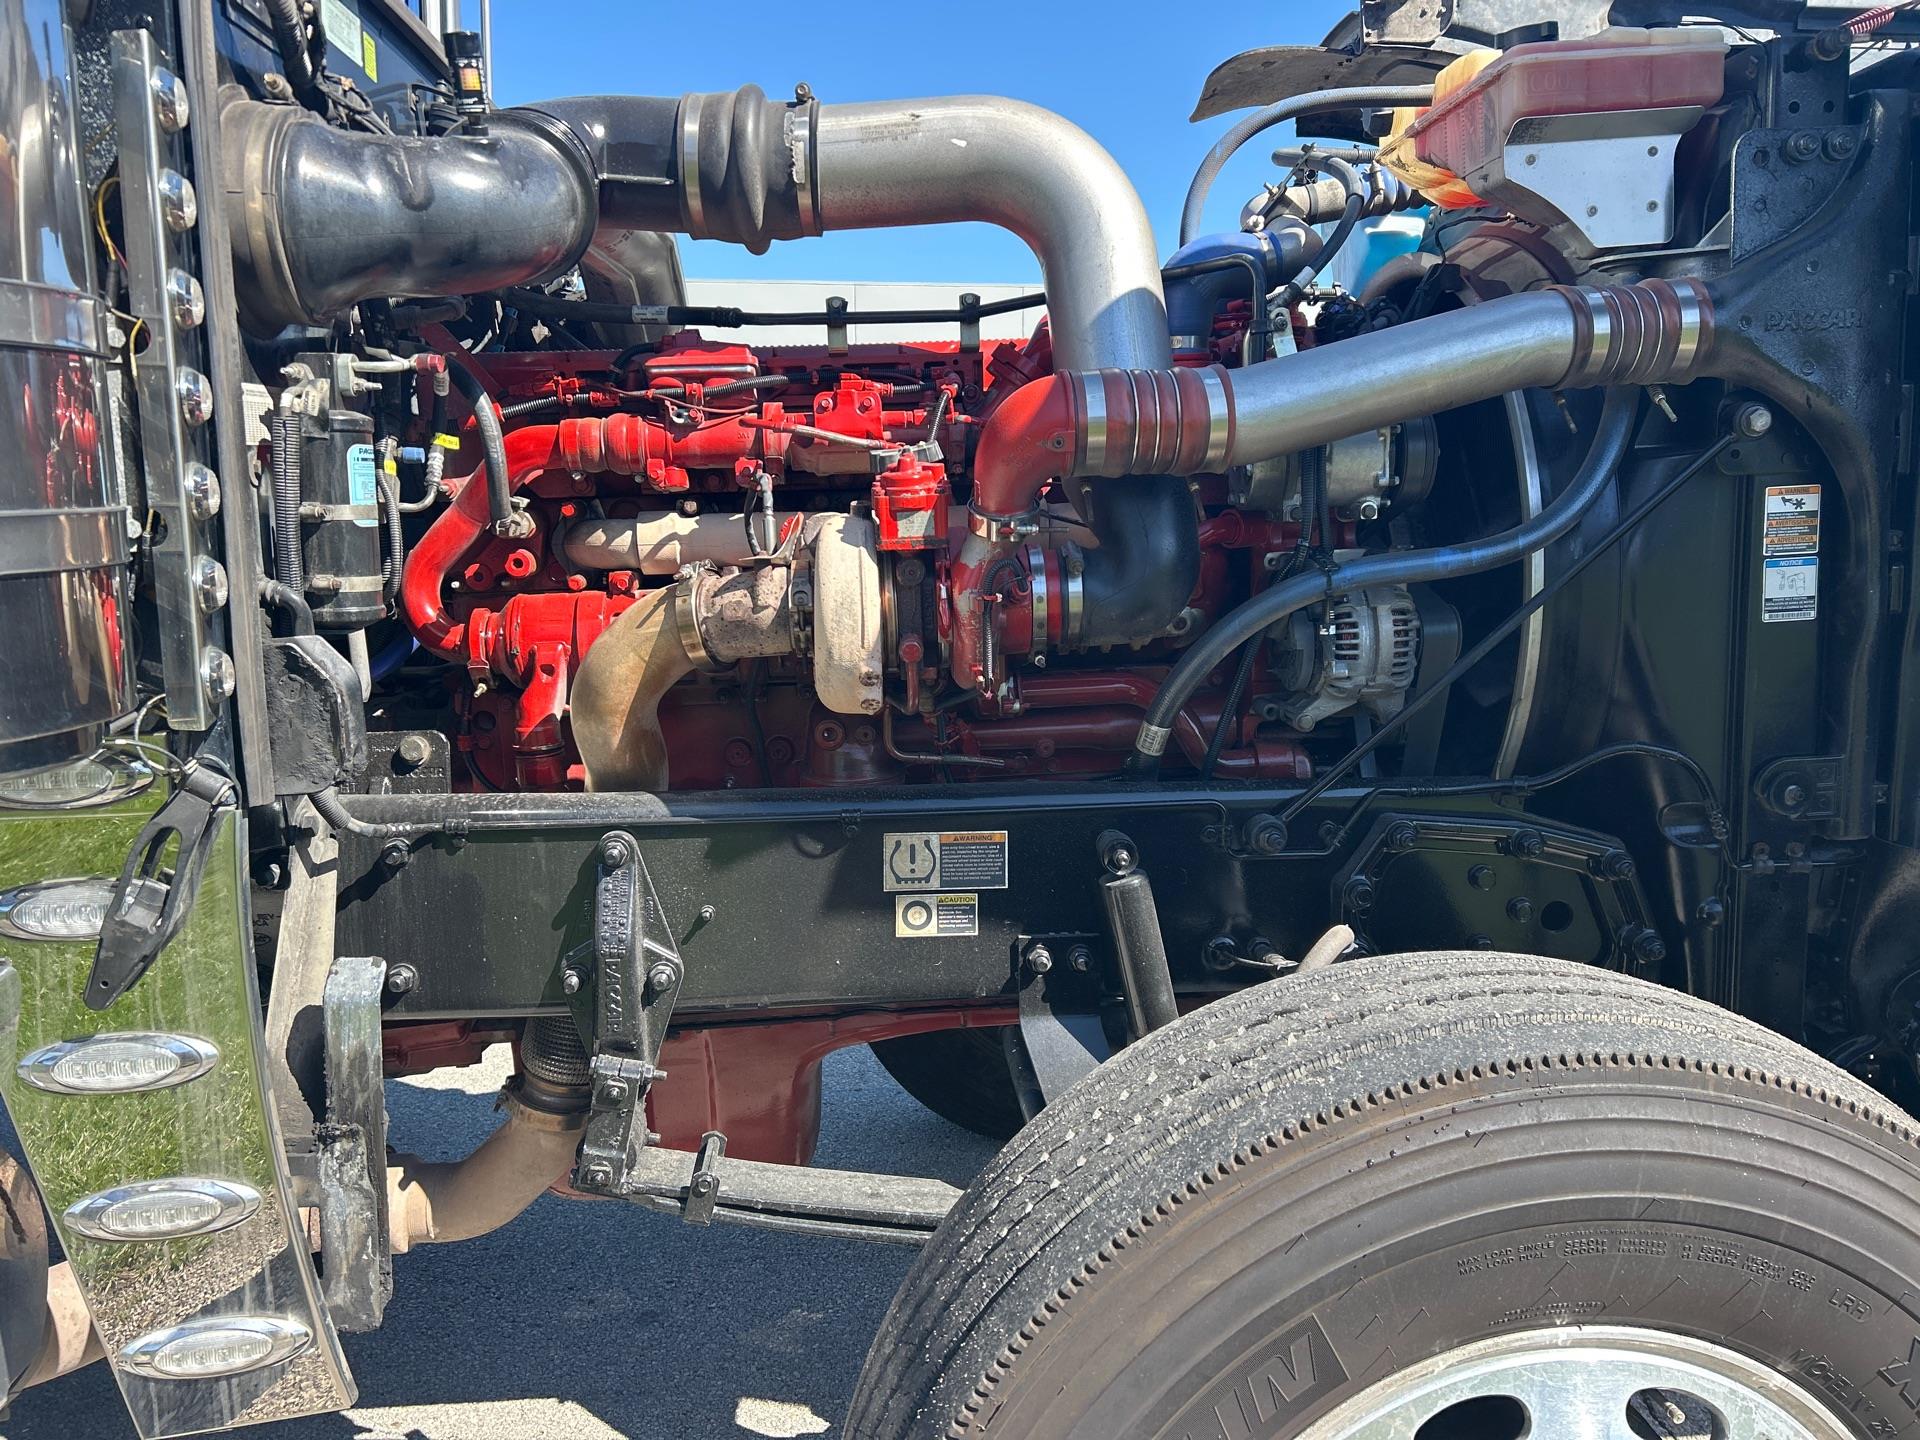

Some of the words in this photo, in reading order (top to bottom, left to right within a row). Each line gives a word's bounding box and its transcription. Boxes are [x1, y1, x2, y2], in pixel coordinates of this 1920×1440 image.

[1764, 308, 1863, 331] PACCAR
[605, 958, 623, 1032] PACCAR
[1457, 1256, 1481, 1268] MAX
[1484, 1247, 1513, 1260] LOAD
[1518, 1240, 1554, 1254] SINGLE
[1792, 1268, 1816, 1284] COLD
[1458, 1265, 1483, 1277] MAX
[1486, 1256, 1514, 1268] LOAD
[1519, 1251, 1547, 1263] DUAL
[1788, 1276, 1811, 1292] COLD
